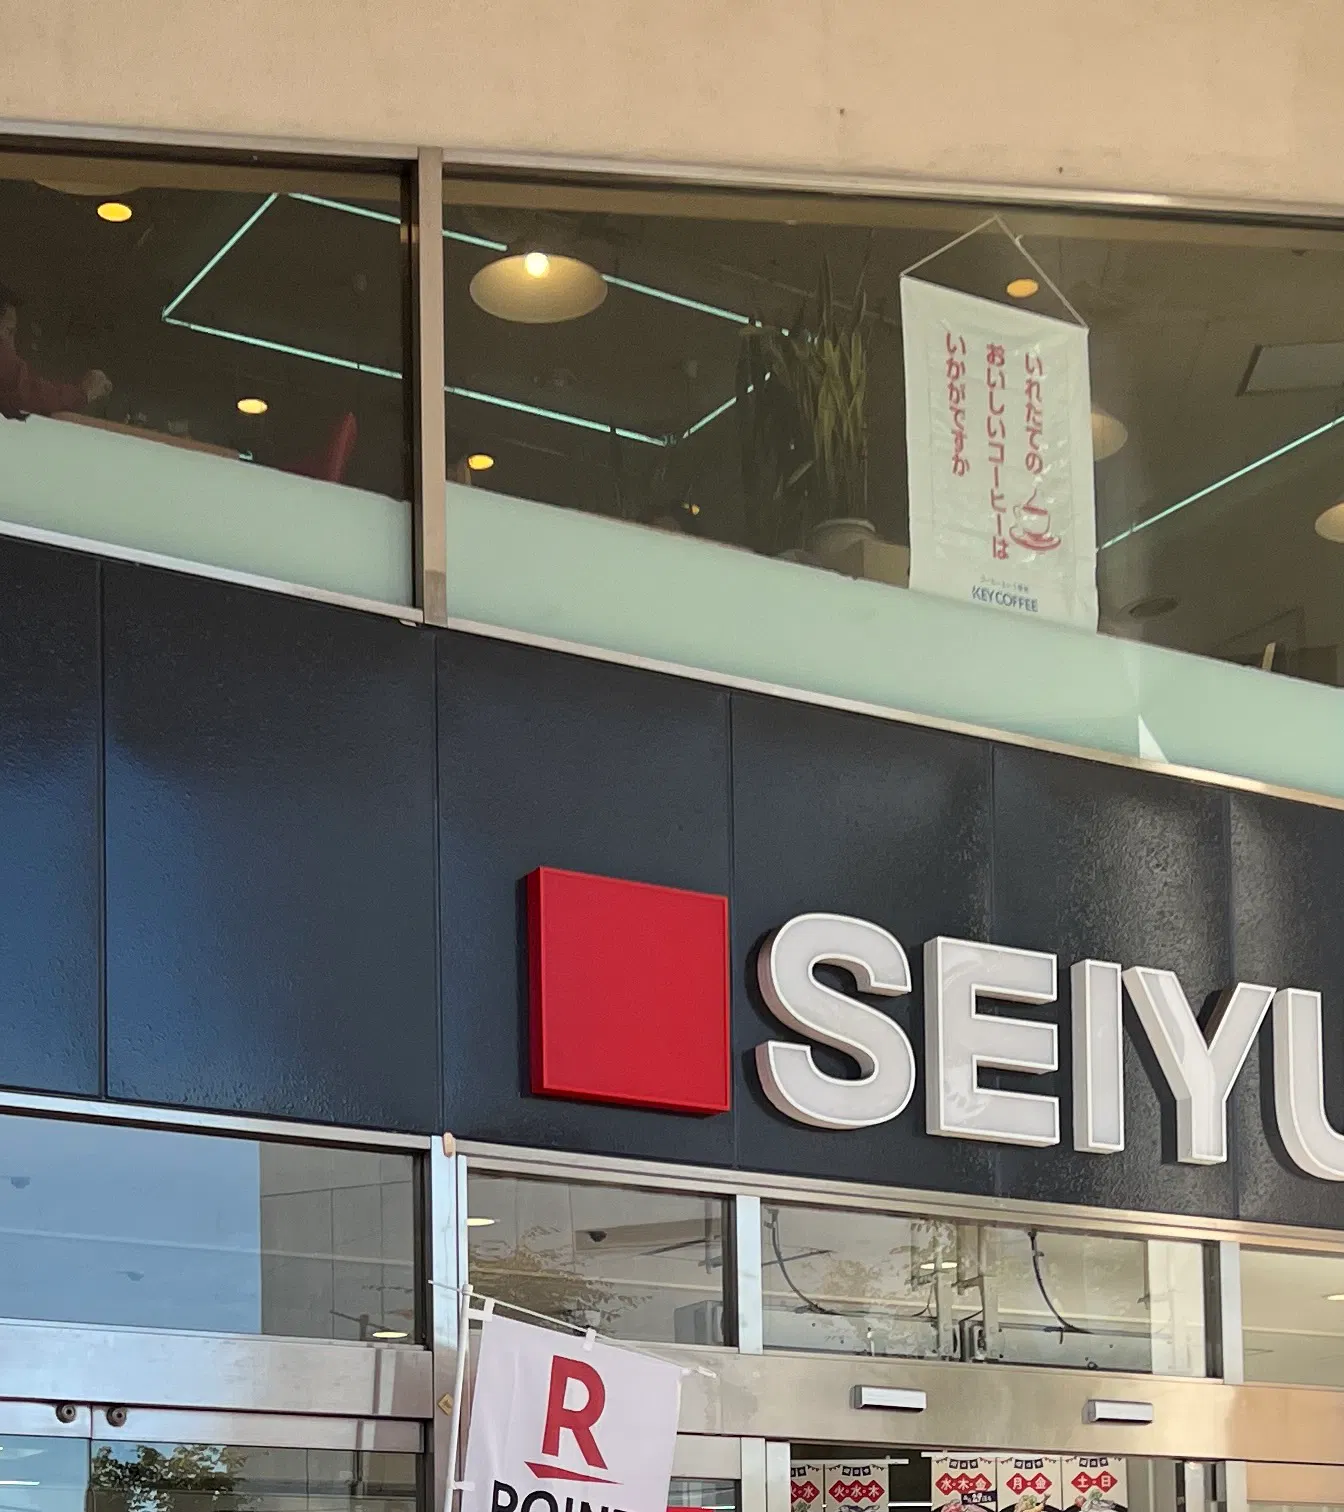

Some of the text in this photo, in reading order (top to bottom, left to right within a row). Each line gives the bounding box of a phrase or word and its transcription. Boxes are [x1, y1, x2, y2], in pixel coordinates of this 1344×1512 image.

[946, 331, 970, 477] いかがですか
[986, 342, 1009, 560] おいしいコーヒーは
[1024, 352, 1045, 475] いれたての
[542, 1354, 609, 1470] R
